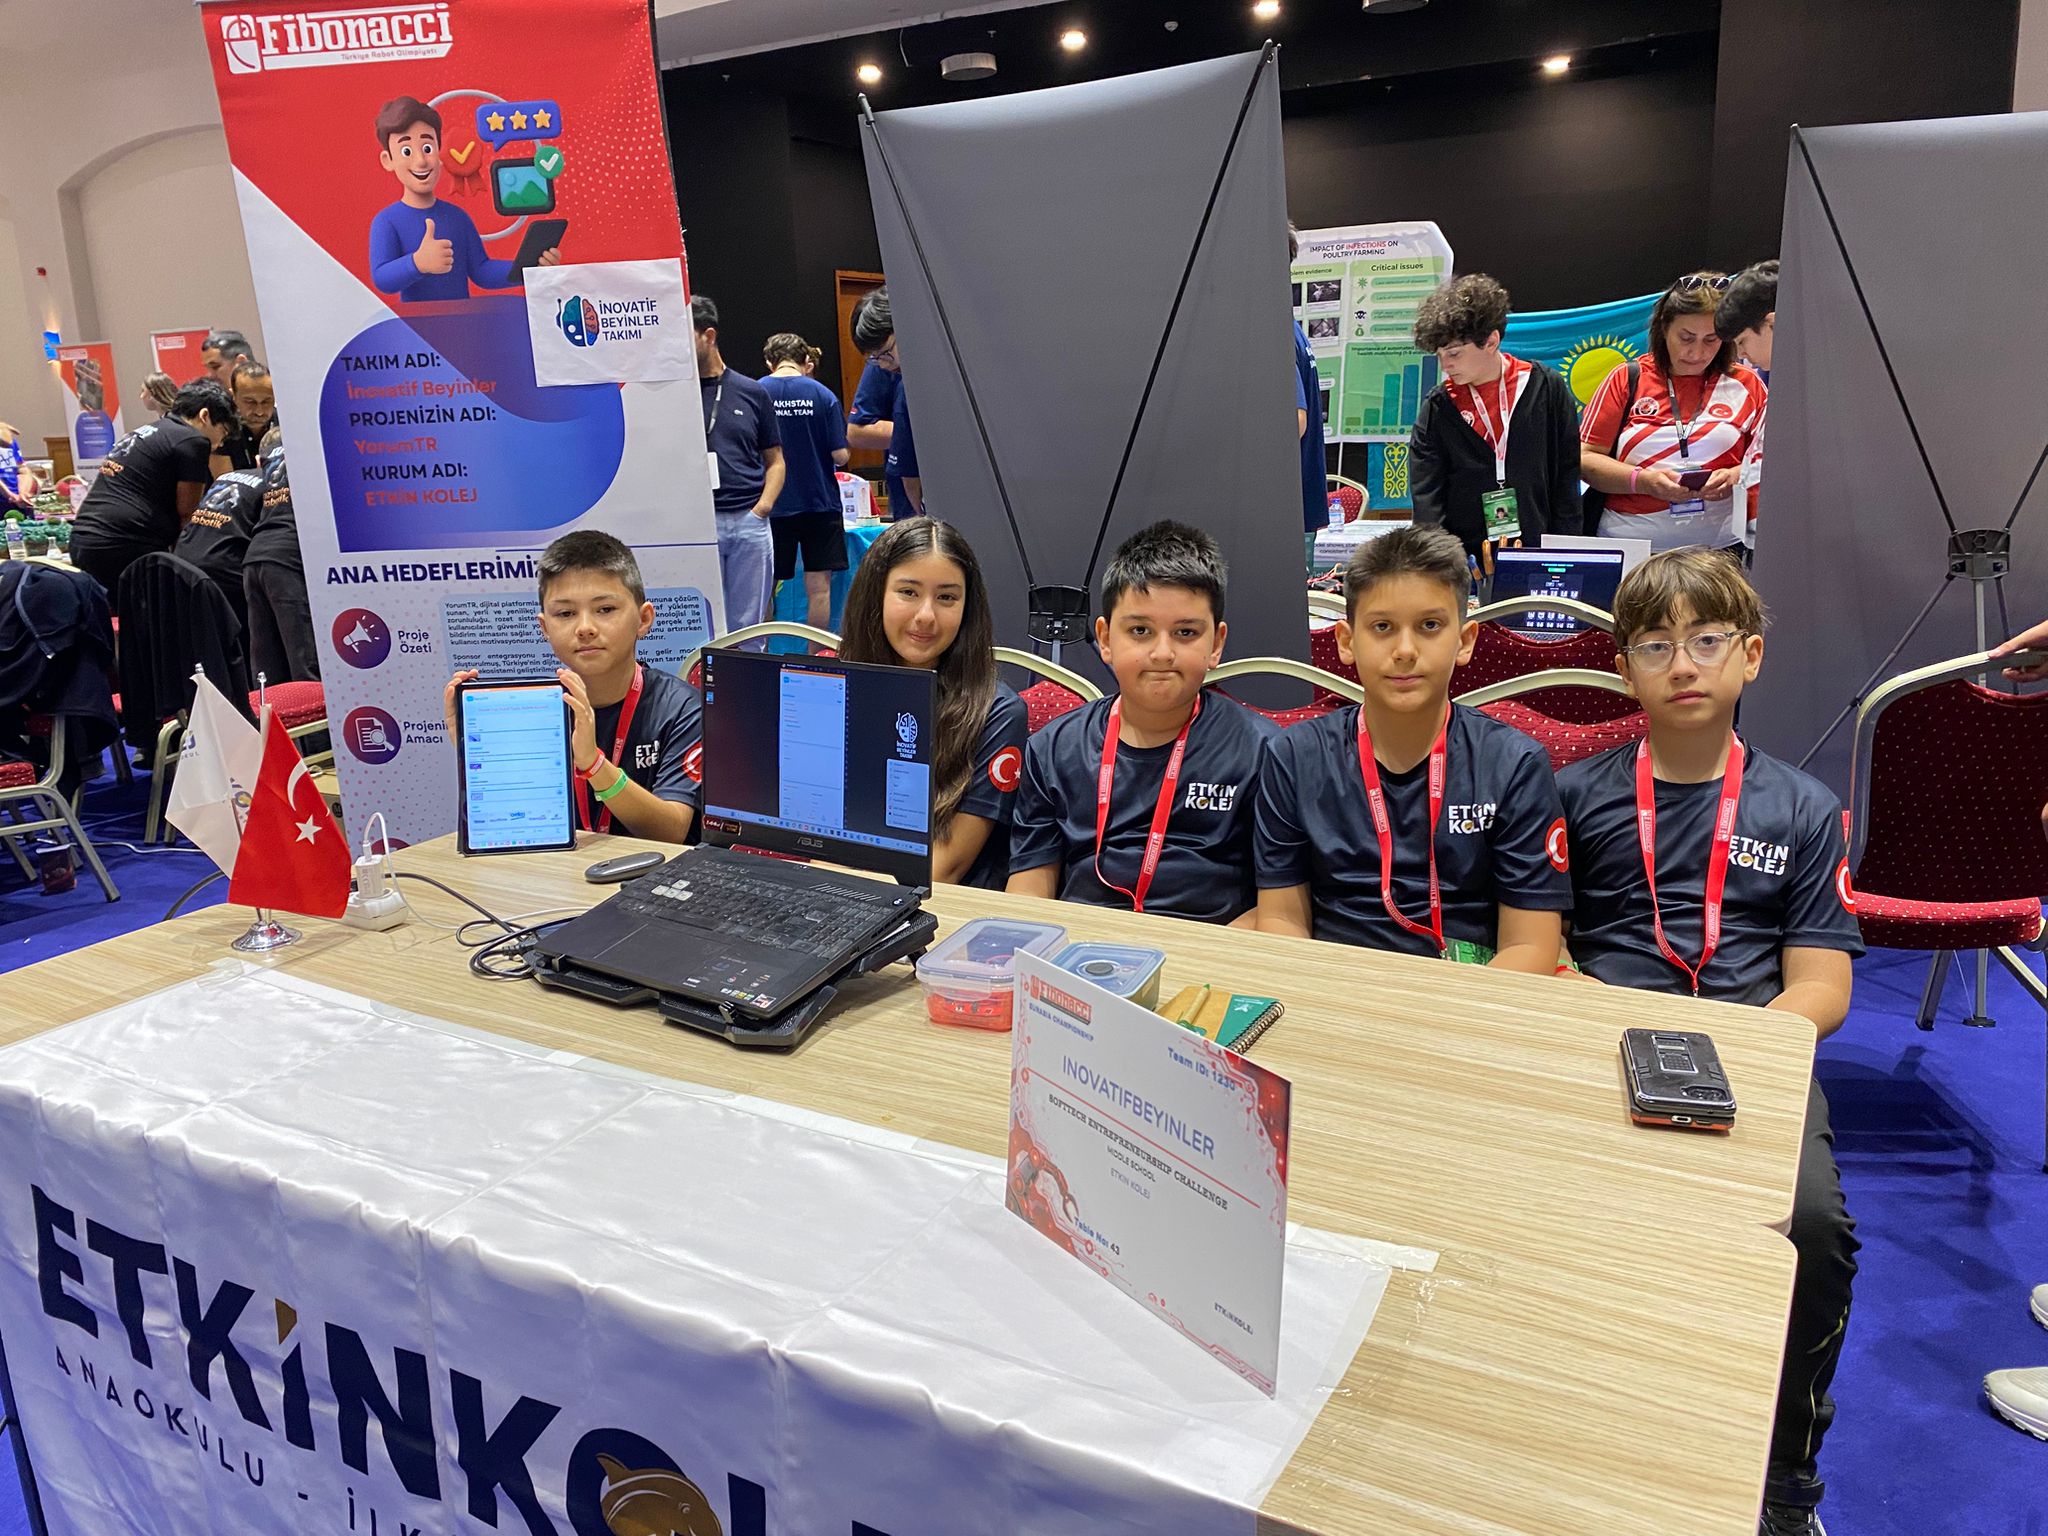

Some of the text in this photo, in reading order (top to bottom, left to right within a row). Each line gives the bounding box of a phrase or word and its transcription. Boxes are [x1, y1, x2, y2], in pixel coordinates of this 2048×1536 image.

[256, 3, 453, 54] Fibonacci
[1346, 241, 1387, 249] INFECTIONS
[1323, 250, 1353, 258] POULTRY
[1371, 264, 1398, 272] Critical
[599, 298, 657, 314] İNOVATİF
[601, 313, 659, 328] BEYİNLER
[602, 329, 642, 341] TAKIMI
[341, 352, 441, 372] TAKIM ADI:
[346, 380, 497, 401] İnovatif Beyinler
[774, 400, 814, 408] AKHSTAN
[349, 403, 496, 427] PROJENİZİN ADI:
[354, 437, 437, 454] YorumTR
[362, 462, 468, 481] KURUM ADI:
[422, 488, 478, 503] KOLEJ
[193, 508, 232, 524] aziantep
[327, 555, 542, 584] ANA HEDEFLERİMİ
[480, 602, 500, 610] dijital
[398, 630, 430, 643] Proje
[400, 640, 432, 654] Özeti
[404, 720, 448, 732] Projeni
[406, 734, 444, 744] Amacı
[1185, 795, 1232, 811] KOLEJ
[796, 836, 824, 848] ASUS
[1167, 1047, 1194, 1071] Team
[1195, 1064, 1210, 1080] ID:
[1062, 1054, 1216, 1160] INOVATIFBEYINLER
[1088, 1118, 1172, 1176] ENTREPRENEURSHIP
[1174, 1170, 1228, 1210] CHALLENGE
[1107, 1145, 1156, 1183] MIDDLE SCHOOL
[1074, 1216, 1120, 1256] Table No: 43
[55, 1345, 264, 1487] ANAOKULU
